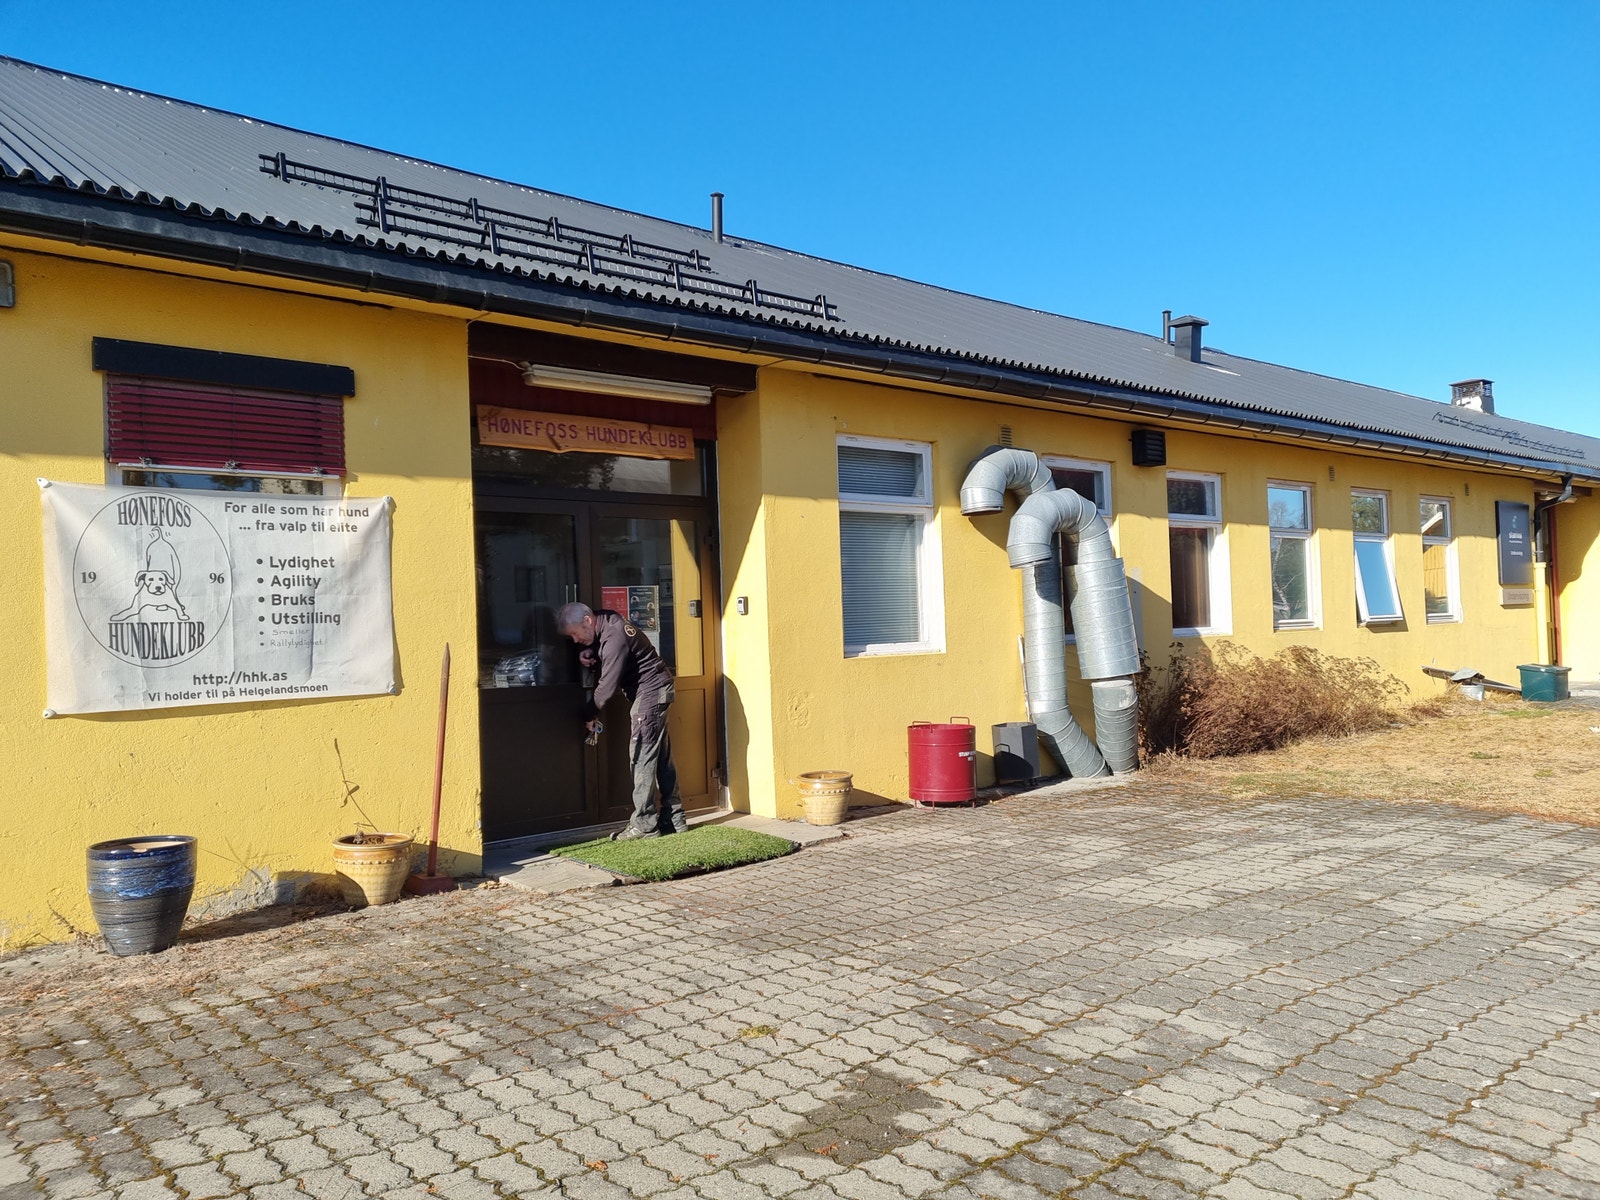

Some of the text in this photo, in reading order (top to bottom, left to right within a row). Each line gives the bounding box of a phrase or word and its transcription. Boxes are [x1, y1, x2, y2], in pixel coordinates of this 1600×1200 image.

[487, 417, 687, 449] HØNEFOSS HUNDEKLUBB
[117, 496, 192, 528] HØNEFOSS
[225, 502, 369, 517] For alle som har hund
[255, 520, 275, 531] fra
[279, 521, 307, 533] valp
[311, 521, 325, 532] til
[329, 522, 358, 533] elite
[269, 556, 335, 571] Lydighet
[80, 571, 97, 584] 19
[209, 572, 225, 584] 96
[270, 575, 321, 589] Agility
[271, 593, 315, 606] Bruks
[271, 612, 341, 626] Utstilling
[108, 621, 205, 660] HUNDEKLUBB
[193, 671, 288, 687] http://hhk.as
[148, 683, 328, 702] Vi holder til på Helgelandsmoen
